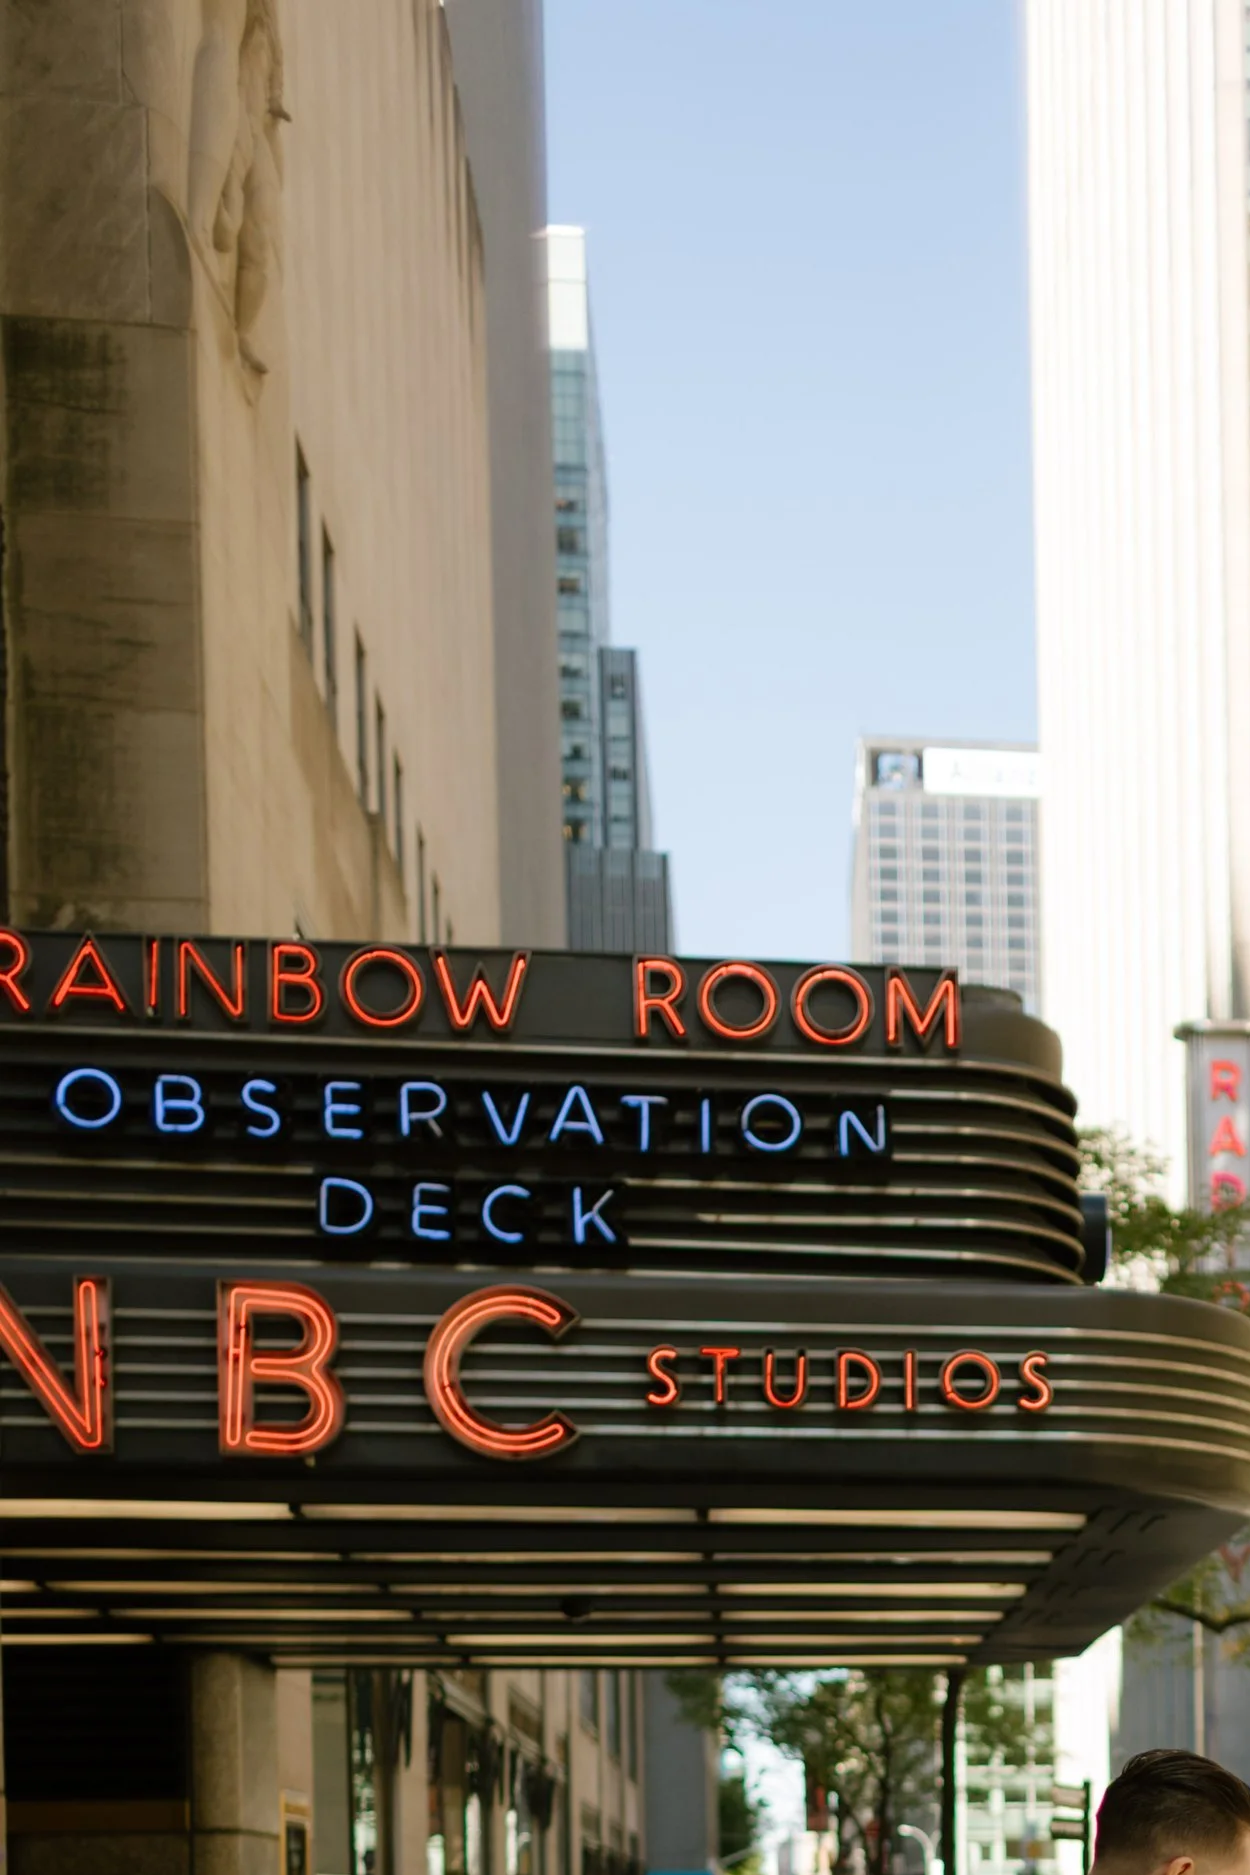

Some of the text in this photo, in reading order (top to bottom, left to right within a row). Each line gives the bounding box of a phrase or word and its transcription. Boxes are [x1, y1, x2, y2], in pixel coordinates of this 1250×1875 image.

[0, 929, 962, 1048] RAINBOW ROOM
[56, 1067, 887, 1157] OBSERVATION
[318, 1177, 617, 1245] DECK
[0, 1275, 1054, 1460] NBC STUDIOS
